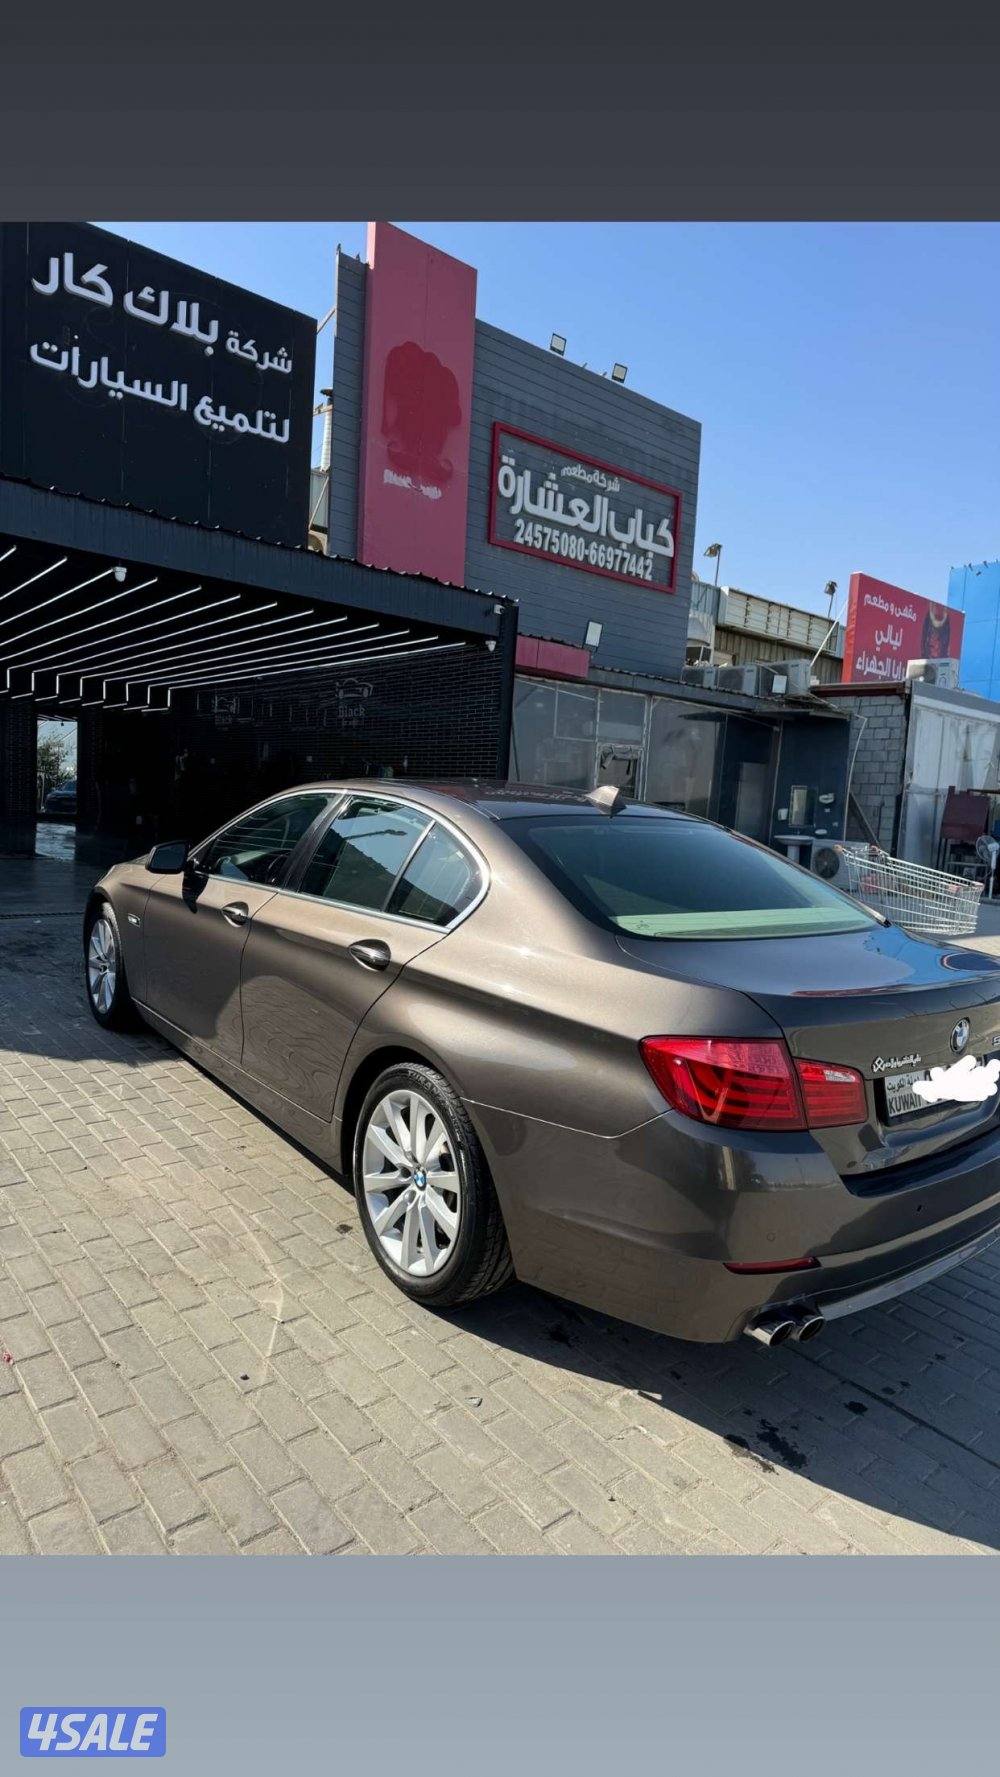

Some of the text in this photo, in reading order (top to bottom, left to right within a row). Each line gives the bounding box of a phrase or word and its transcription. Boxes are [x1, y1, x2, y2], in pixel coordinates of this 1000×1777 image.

[31, 252, 292, 374] شركة بلاك كار
[30, 340, 289, 443] لتلميع السيارات
[498, 455, 609, 537] العشارة
[514, 518, 653, 581] 24575080-66977442
[609, 508, 675, 558] كباب
[864, 593, 889, 613] مطعم
[855, 650, 891, 680] الجهراء
[875, 624, 903, 651] ليالي
